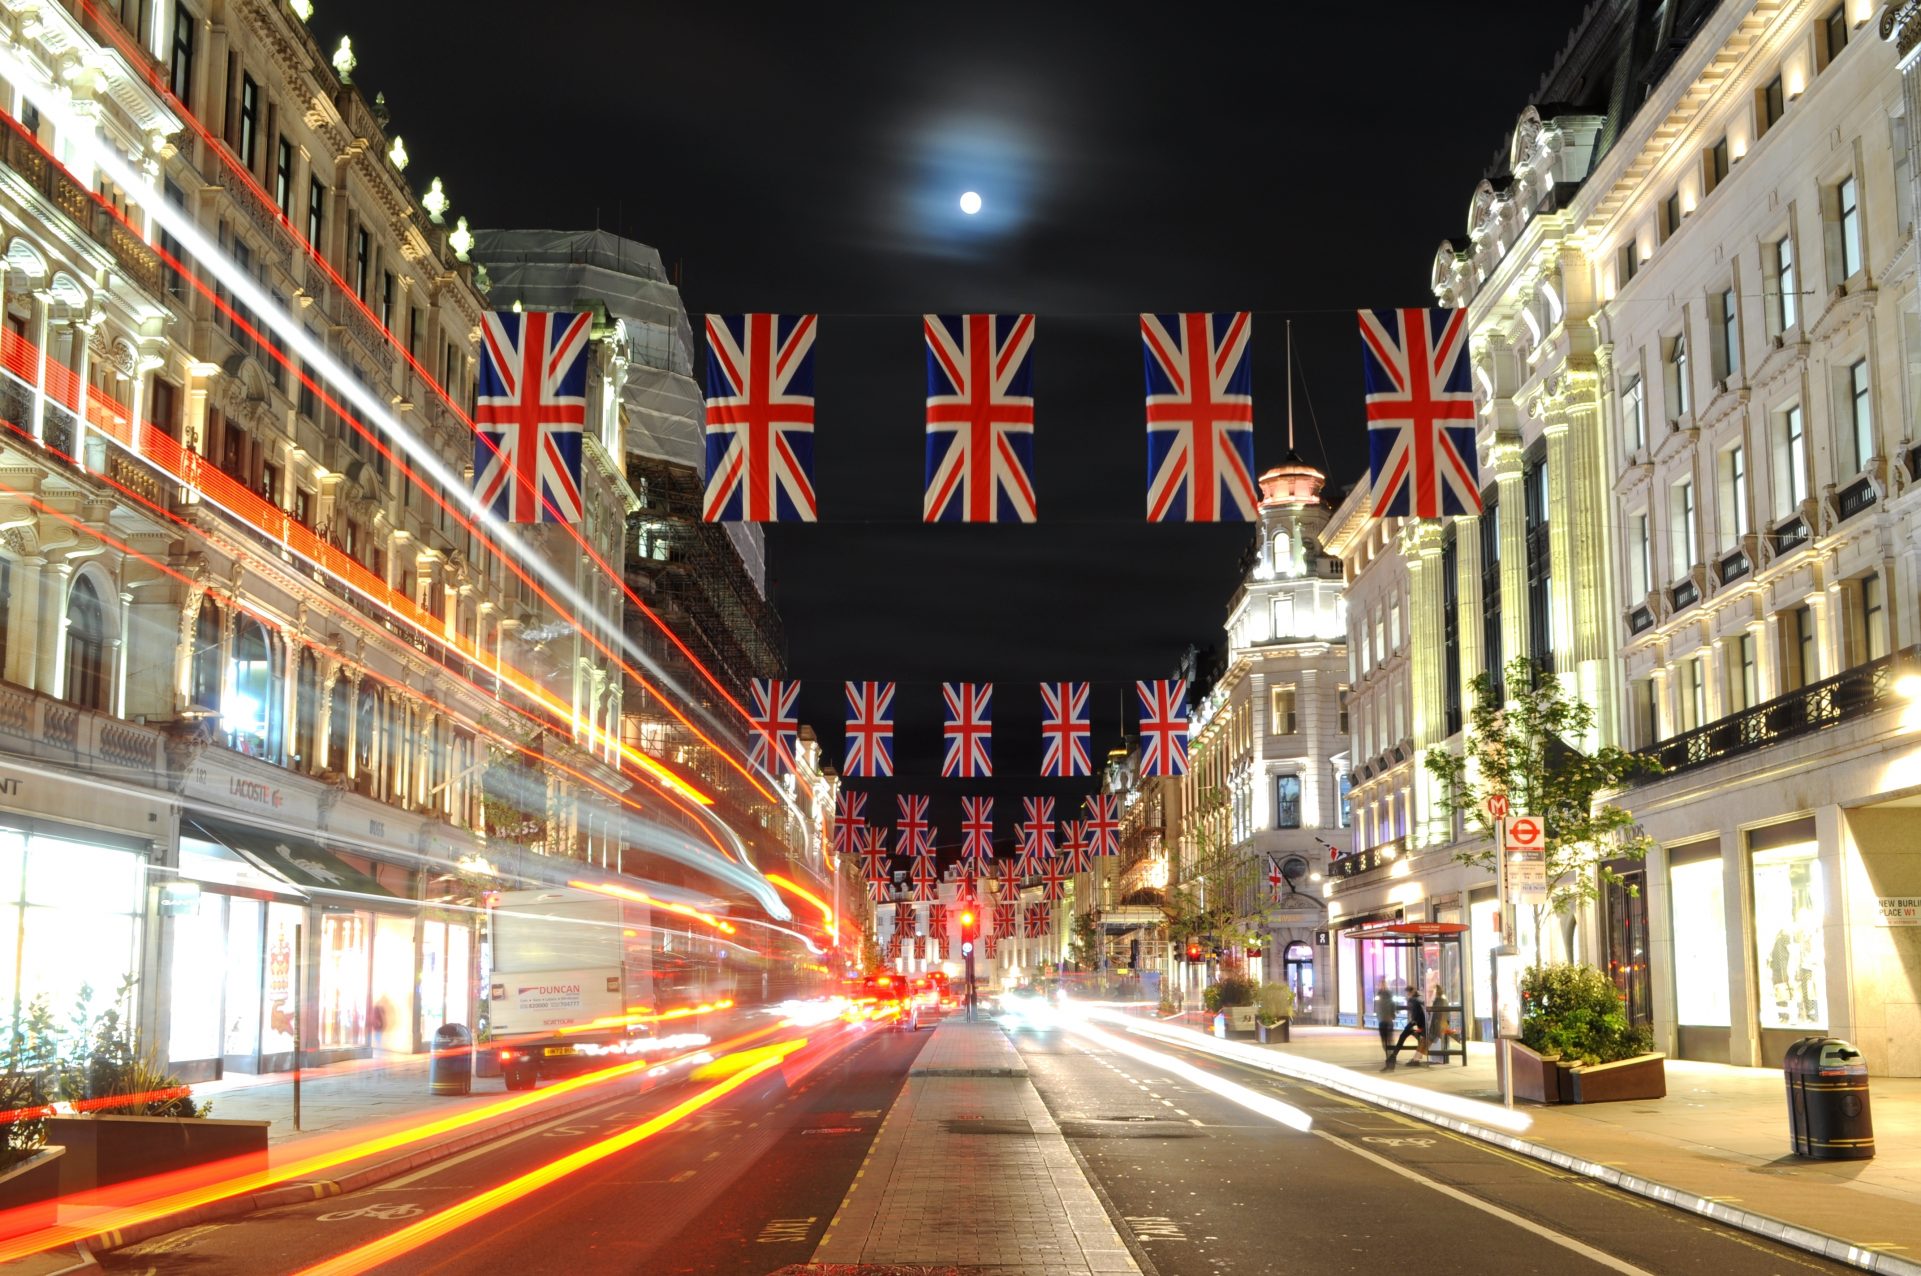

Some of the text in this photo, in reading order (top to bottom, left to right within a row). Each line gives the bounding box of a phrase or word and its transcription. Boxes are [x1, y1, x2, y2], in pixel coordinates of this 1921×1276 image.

[229, 775, 269, 804] LACOSTE
[1490, 798, 1506, 814] M
[1879, 899, 1894, 907] NEW
[539, 985, 580, 994] DUNCAN
[603, 1108, 741, 1121] BS
[756, 1216, 818, 1242] TAXIS
